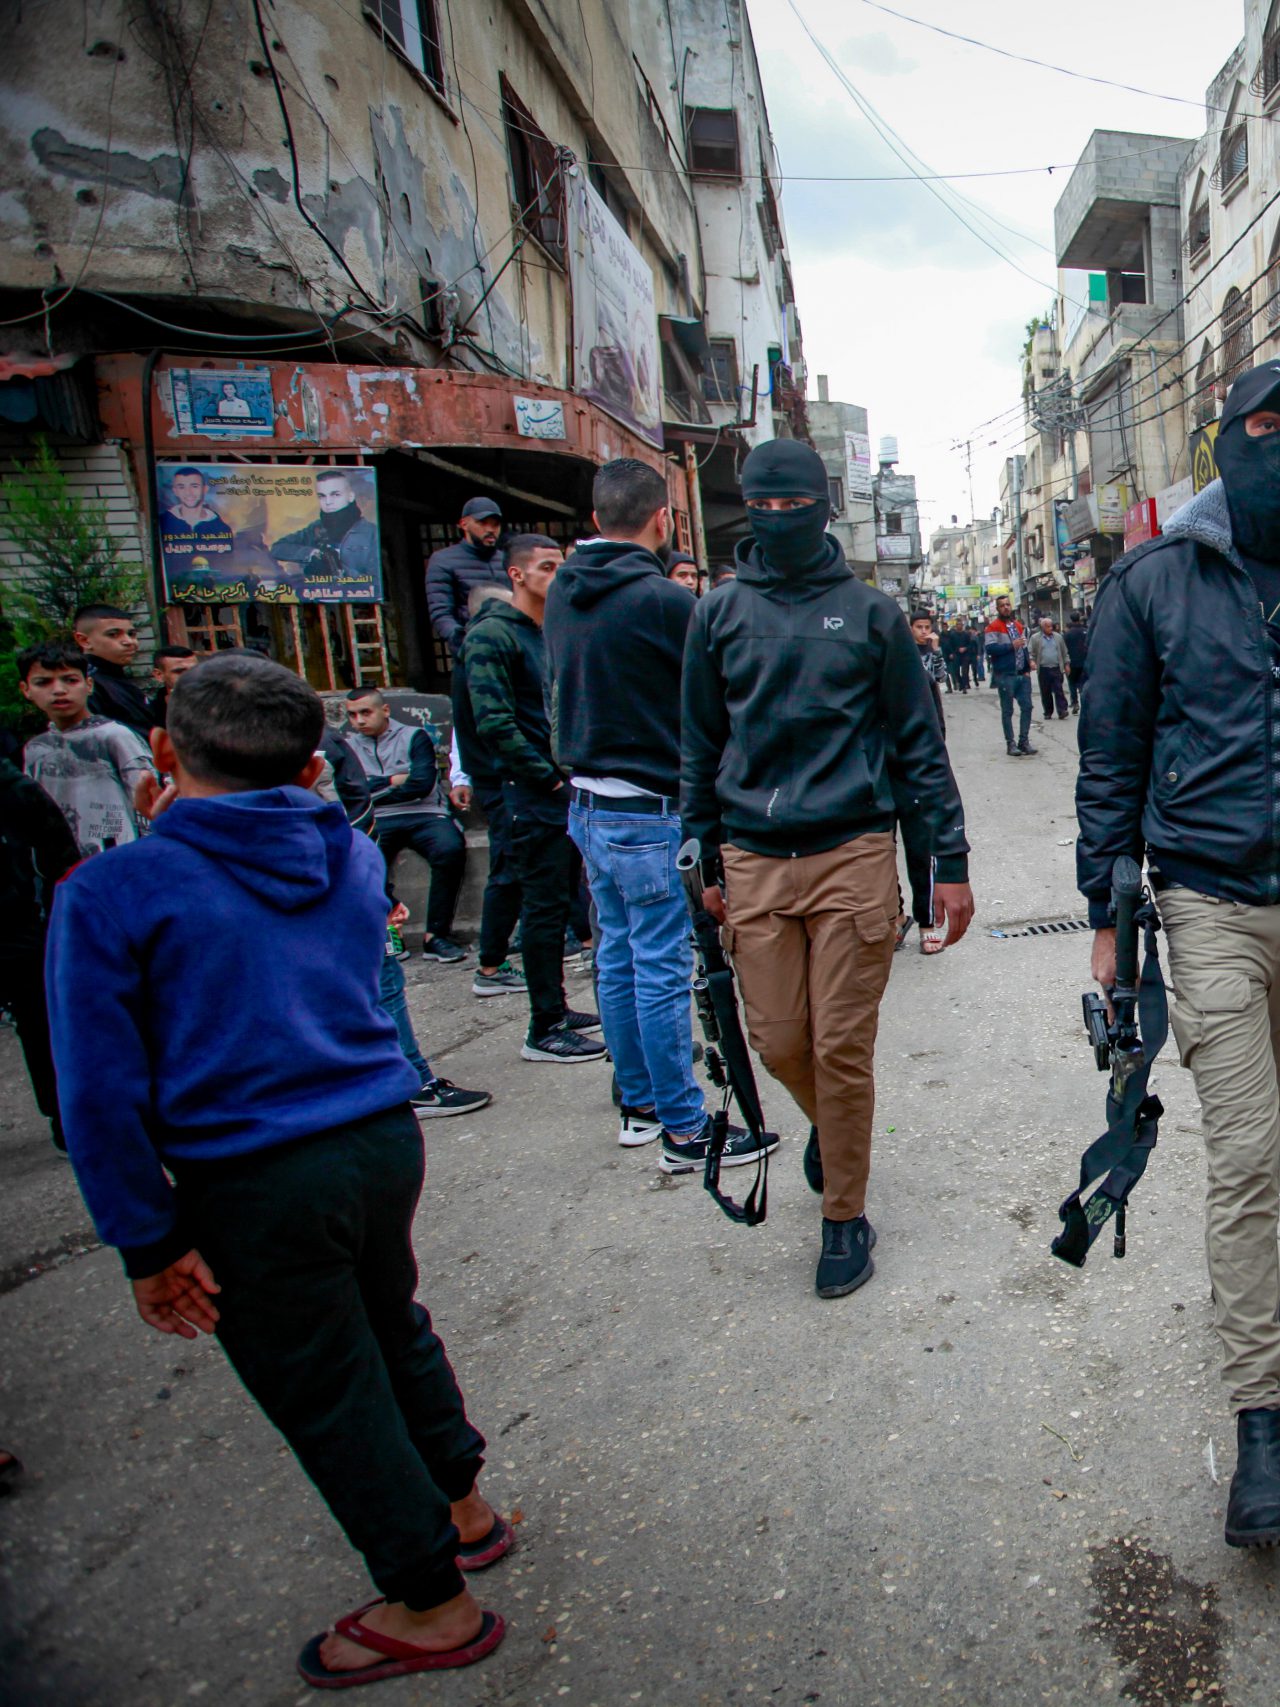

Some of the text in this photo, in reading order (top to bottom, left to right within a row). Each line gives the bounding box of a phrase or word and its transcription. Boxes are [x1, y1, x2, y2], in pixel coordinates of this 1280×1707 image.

[201, 531, 233, 541] الشهيد
[303, 574, 373, 584] الشهيد القائد
[346, 585, 375, 598] أحمد
